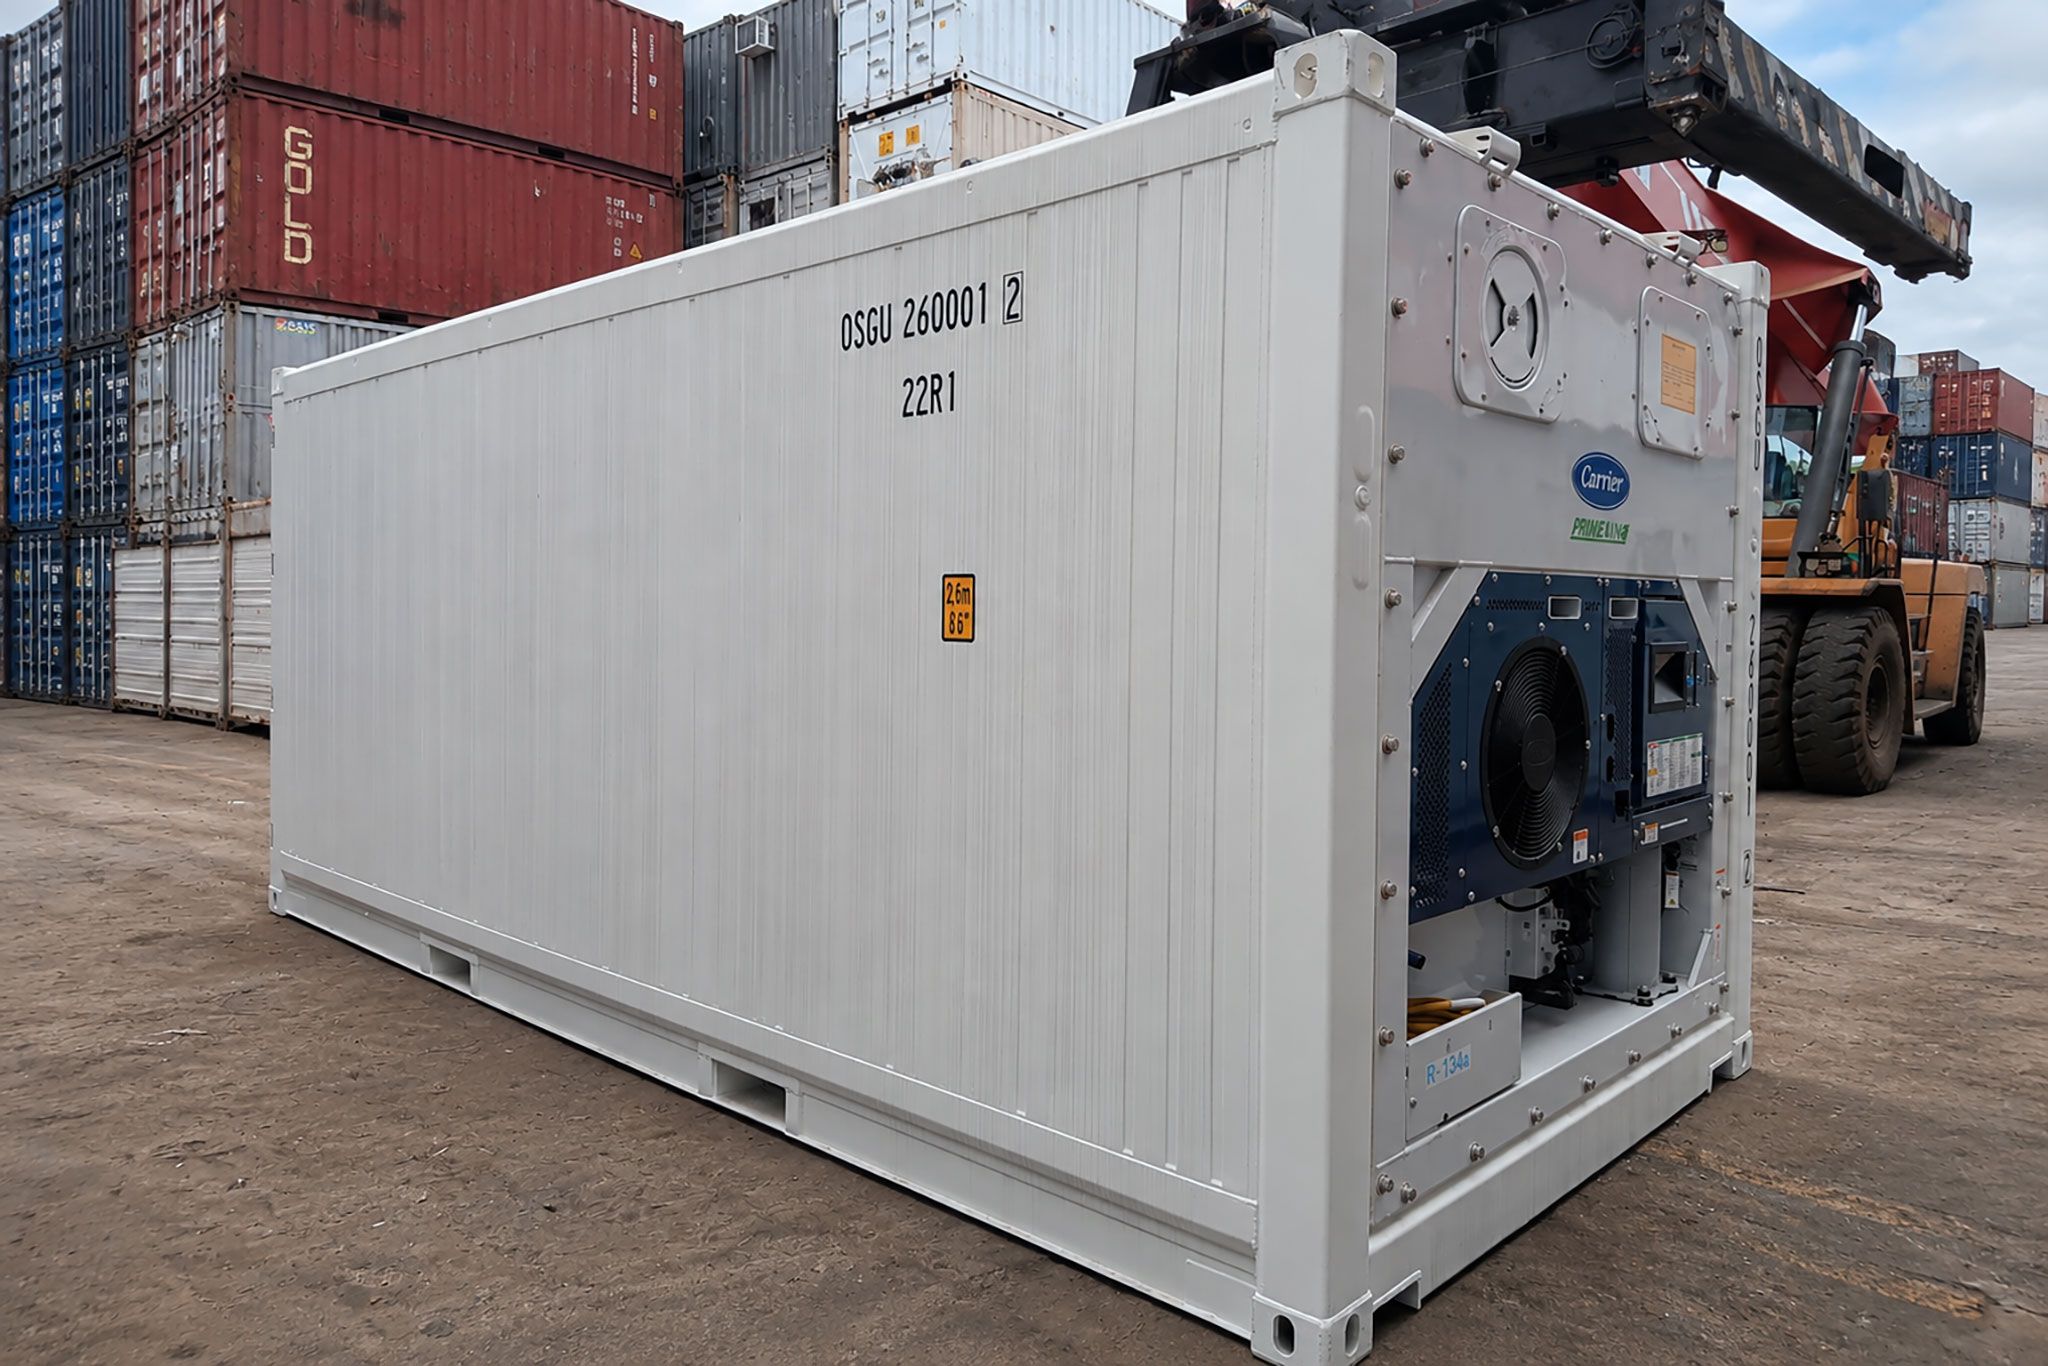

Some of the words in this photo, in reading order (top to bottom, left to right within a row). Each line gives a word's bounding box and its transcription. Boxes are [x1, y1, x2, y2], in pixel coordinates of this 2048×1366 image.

[284, 125, 313, 265] GOLD
[841, 303, 892, 351] OSGU
[903, 282, 986, 338] 260001
[1006, 276, 1020, 321] 2
[902, 370, 955, 418] 22R1
[1753, 336, 1763, 472] OSGU
[1581, 464, 1624, 493] Carrier
[1746, 613, 1756, 817] 260001
[1426, 1051, 1471, 1085] R-134a
